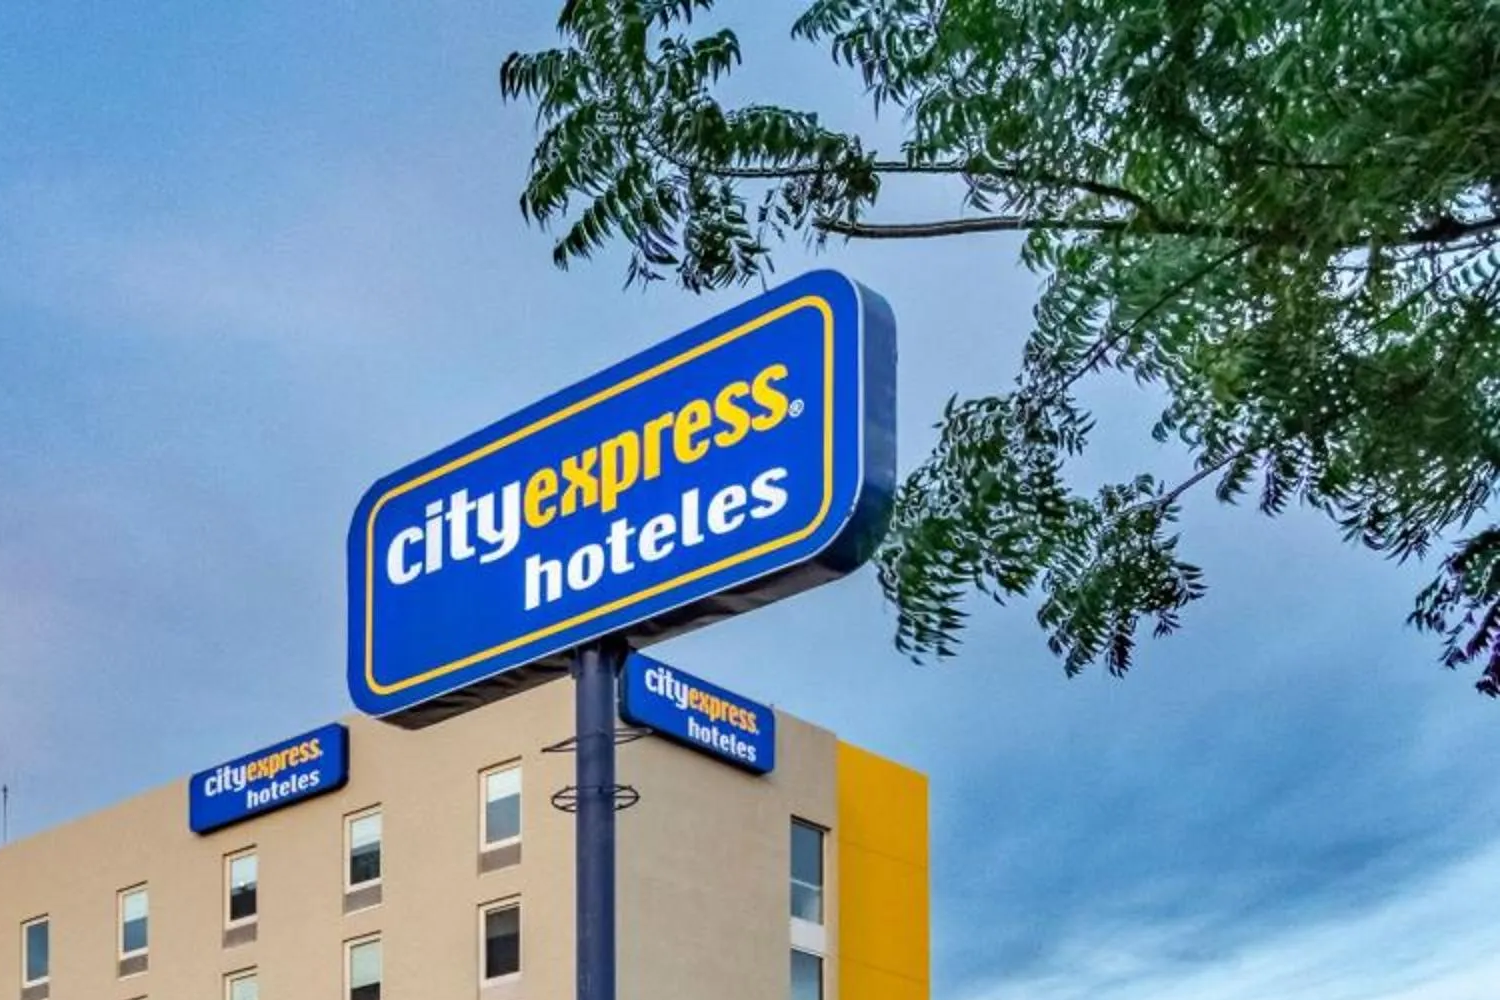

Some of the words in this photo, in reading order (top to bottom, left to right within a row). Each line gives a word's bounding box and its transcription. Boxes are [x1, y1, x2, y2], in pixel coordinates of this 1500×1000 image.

[524, 466, 789, 611] hoteles
[687, 716, 757, 762] hoteles
[246, 769, 321, 809] hoteles
